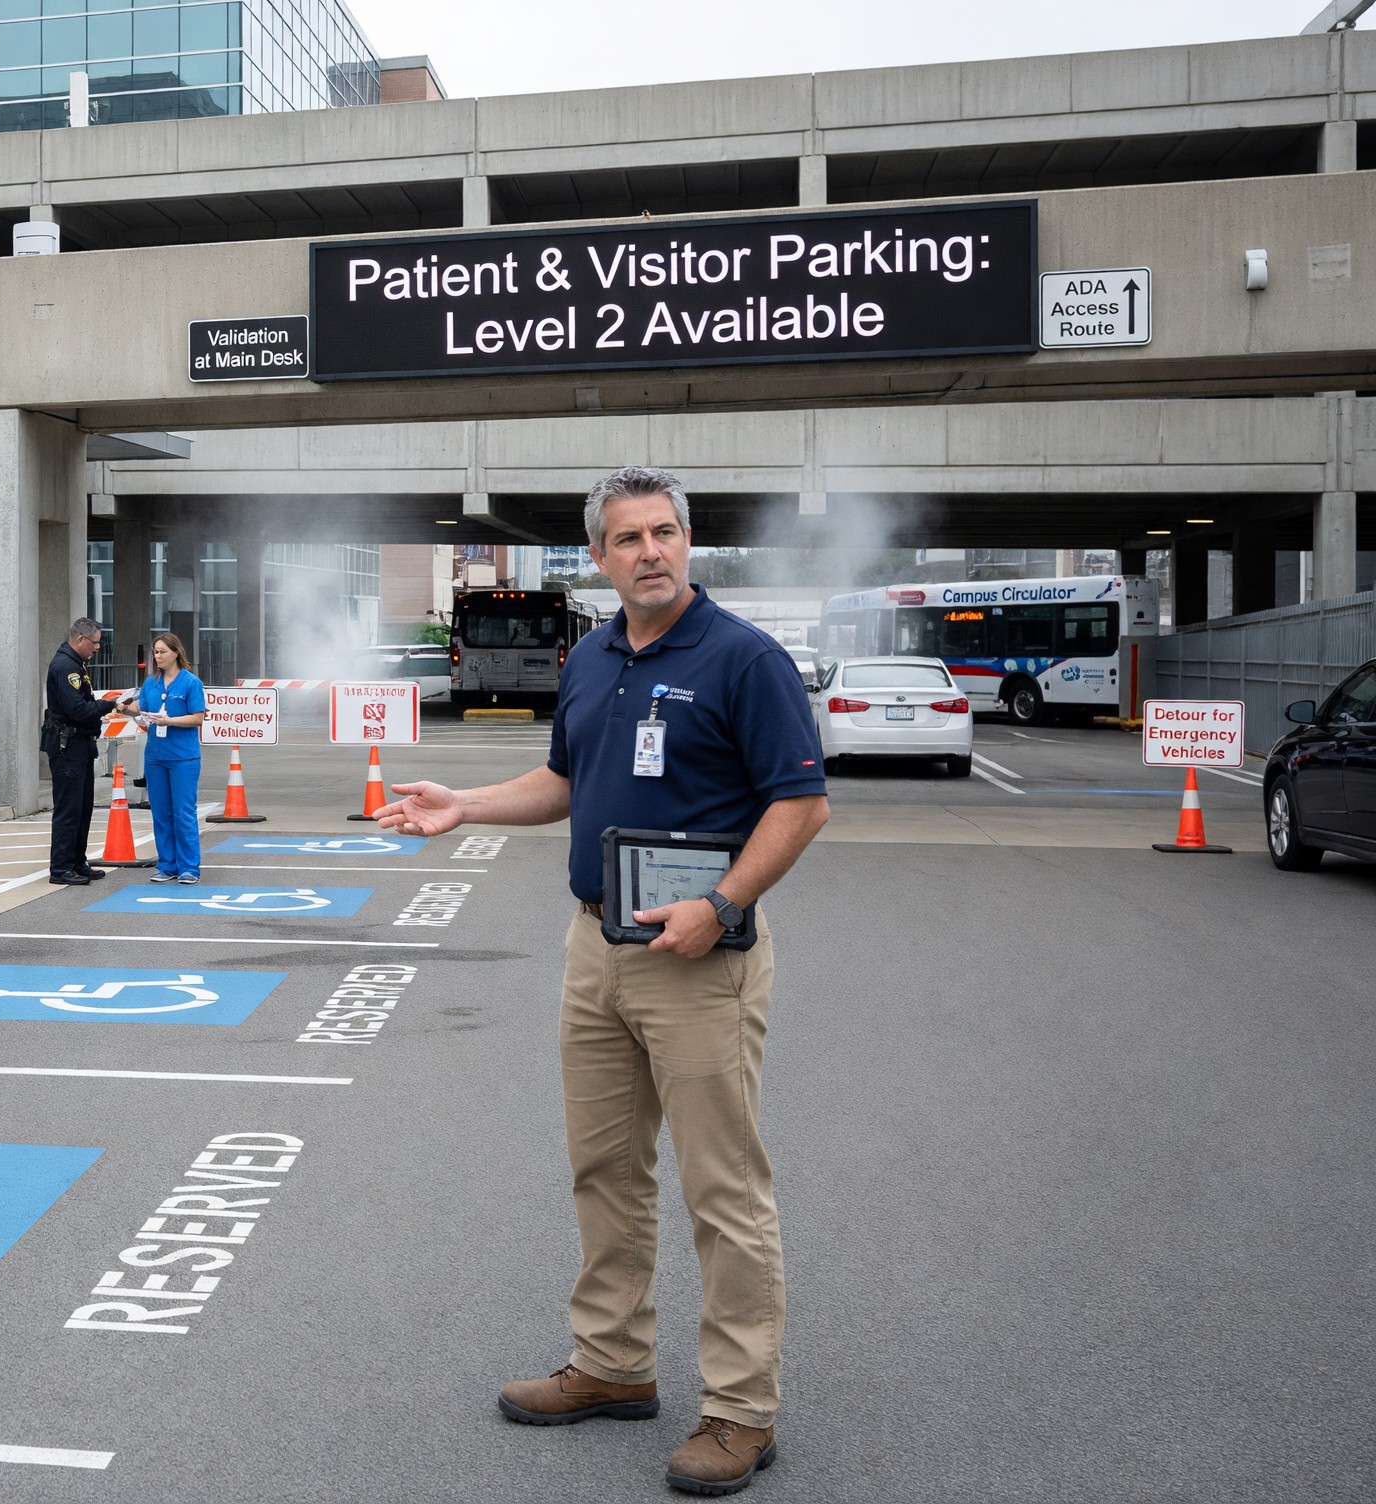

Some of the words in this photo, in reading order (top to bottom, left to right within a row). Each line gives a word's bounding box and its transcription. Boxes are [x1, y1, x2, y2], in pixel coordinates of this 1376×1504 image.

[348, 250, 520, 302] Patient
[535, 247, 573, 292] &
[586, 241, 752, 289] Visitor
[769, 228, 990, 284] Parking:
[1064, 279, 1108, 296] ADA
[1050, 301, 1120, 317] Access
[445, 305, 577, 356] Level
[595, 302, 626, 349] 2
[641, 291, 885, 346] Available
[1060, 320, 1115, 337] Route
[207, 327, 289, 347] Validation
[194, 352, 211, 369] at
[215, 351, 256, 368] Main
[260, 348, 304, 366] Desk
[942, 588, 998, 604] Campus
[1001, 585, 1077, 601] Circulator
[253, 694, 271, 705] for
[1154, 707, 1206, 721] Detour
[1212, 708, 1235, 722] for
[1148, 726, 1237, 744] Emergency
[1161, 745, 1225, 759] Vehicles
[295, 964, 419, 1045] RESERVED
[63, 1131, 305, 1335] RESERVED
